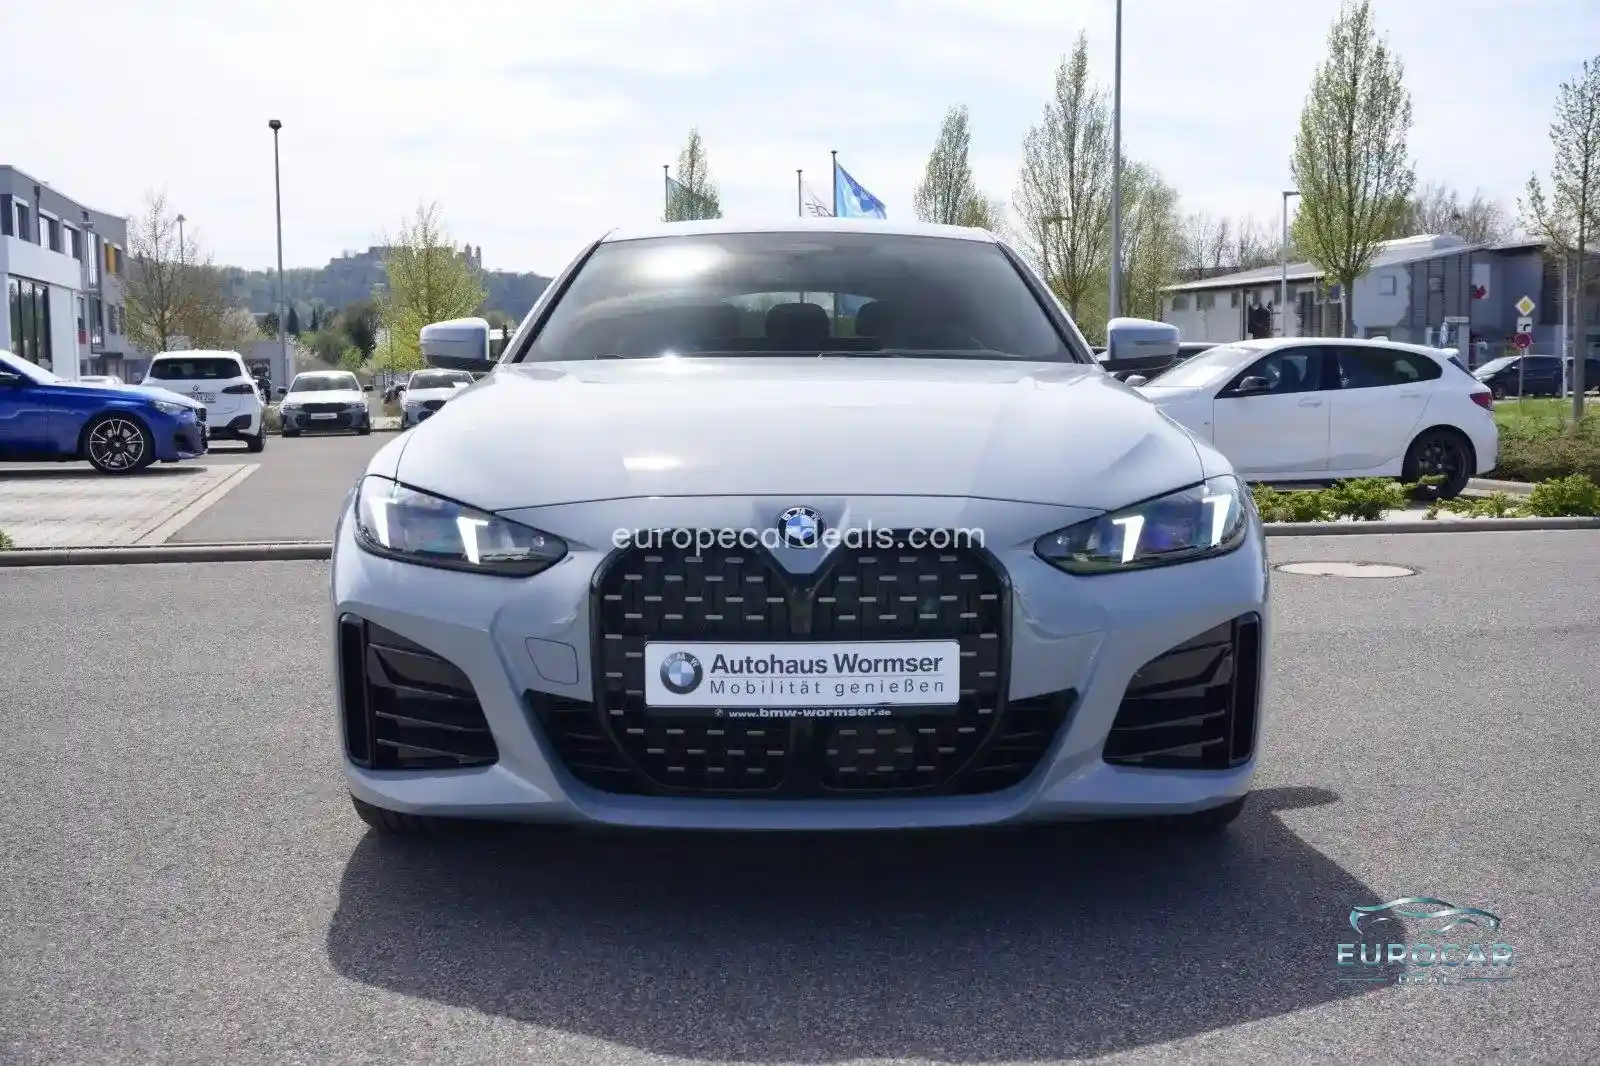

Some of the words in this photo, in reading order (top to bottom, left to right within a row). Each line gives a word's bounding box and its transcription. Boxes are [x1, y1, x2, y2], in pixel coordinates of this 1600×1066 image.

[710, 653, 828, 674] Autohaus
[832, 653, 944, 674] Wormser
[710, 680, 821, 695] Mobilität
[834, 678, 945, 697] genießen
[728, 707, 892, 718] www.bmw-wormser.de
